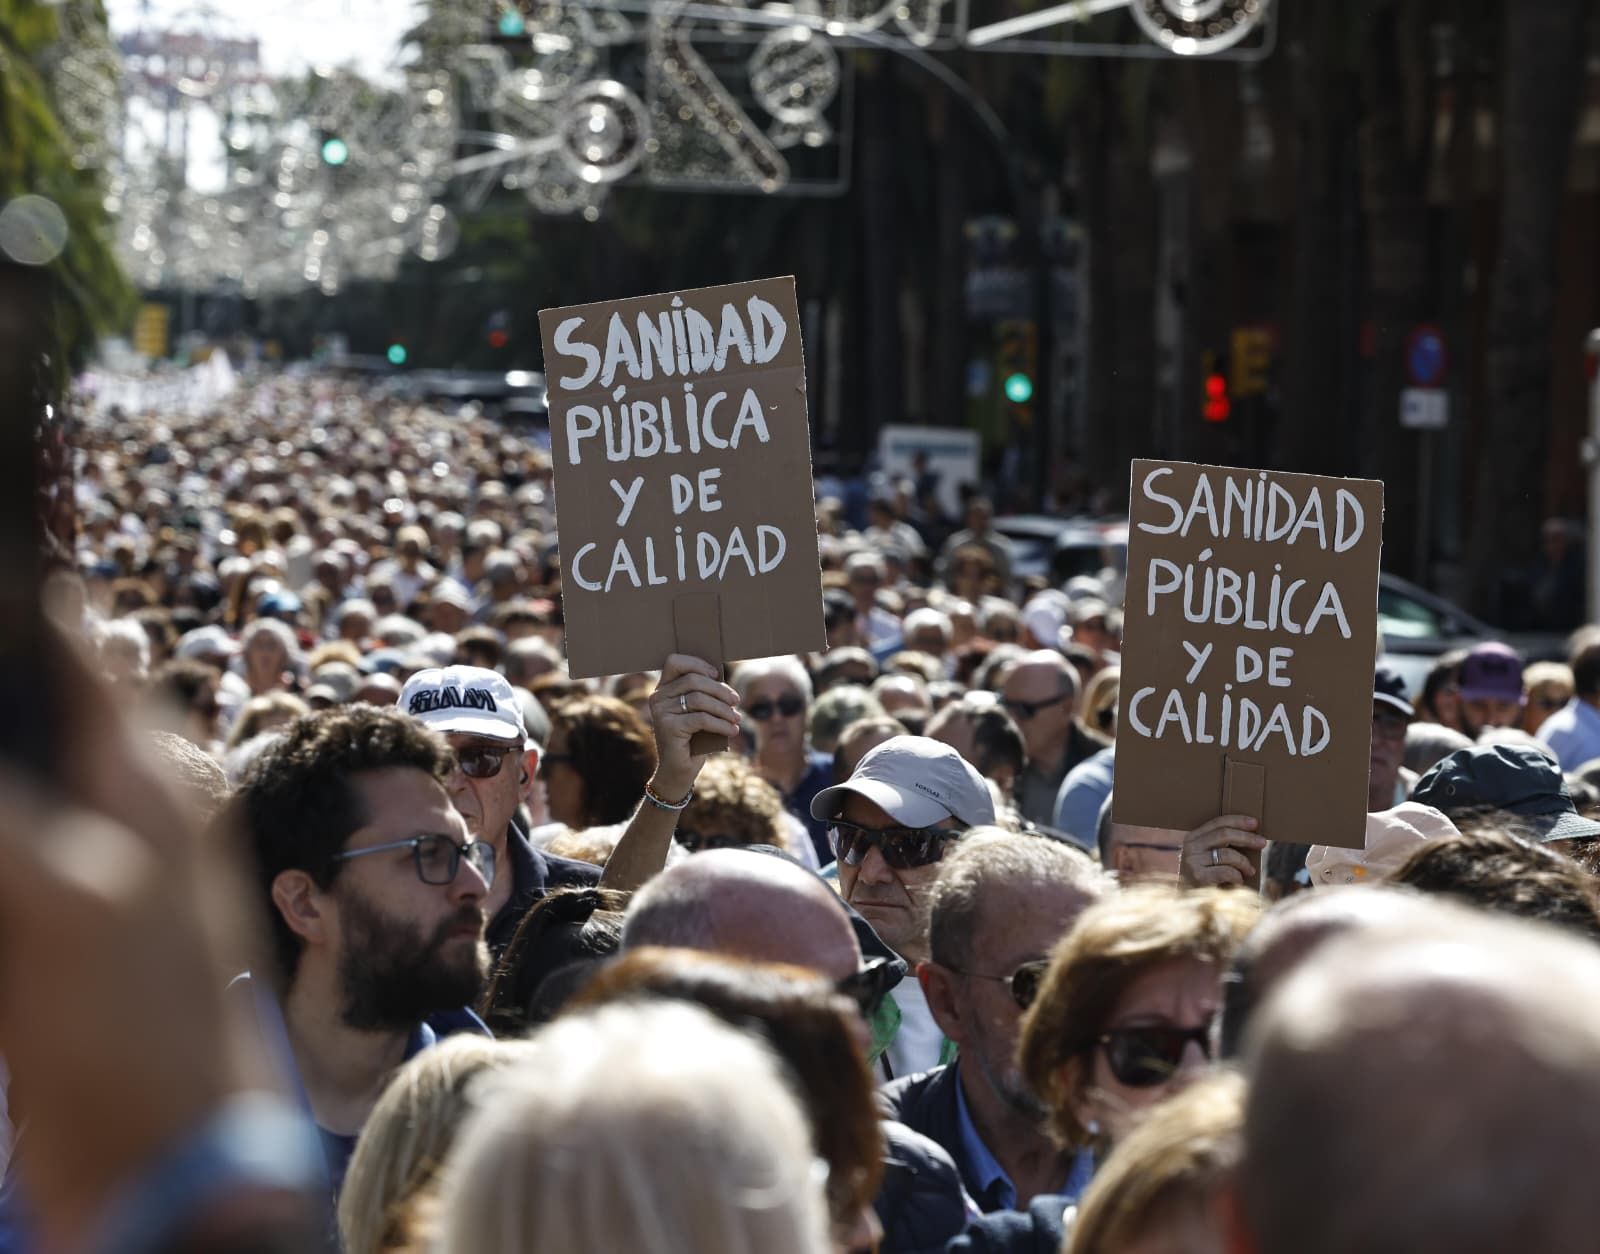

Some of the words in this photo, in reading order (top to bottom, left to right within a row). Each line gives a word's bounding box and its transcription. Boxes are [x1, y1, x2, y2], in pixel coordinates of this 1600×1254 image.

[609, 476, 645, 527] Y
[670, 468, 723, 515] DE
[1182, 640, 1213, 684] Y
[1236, 645, 1294, 687] DE
